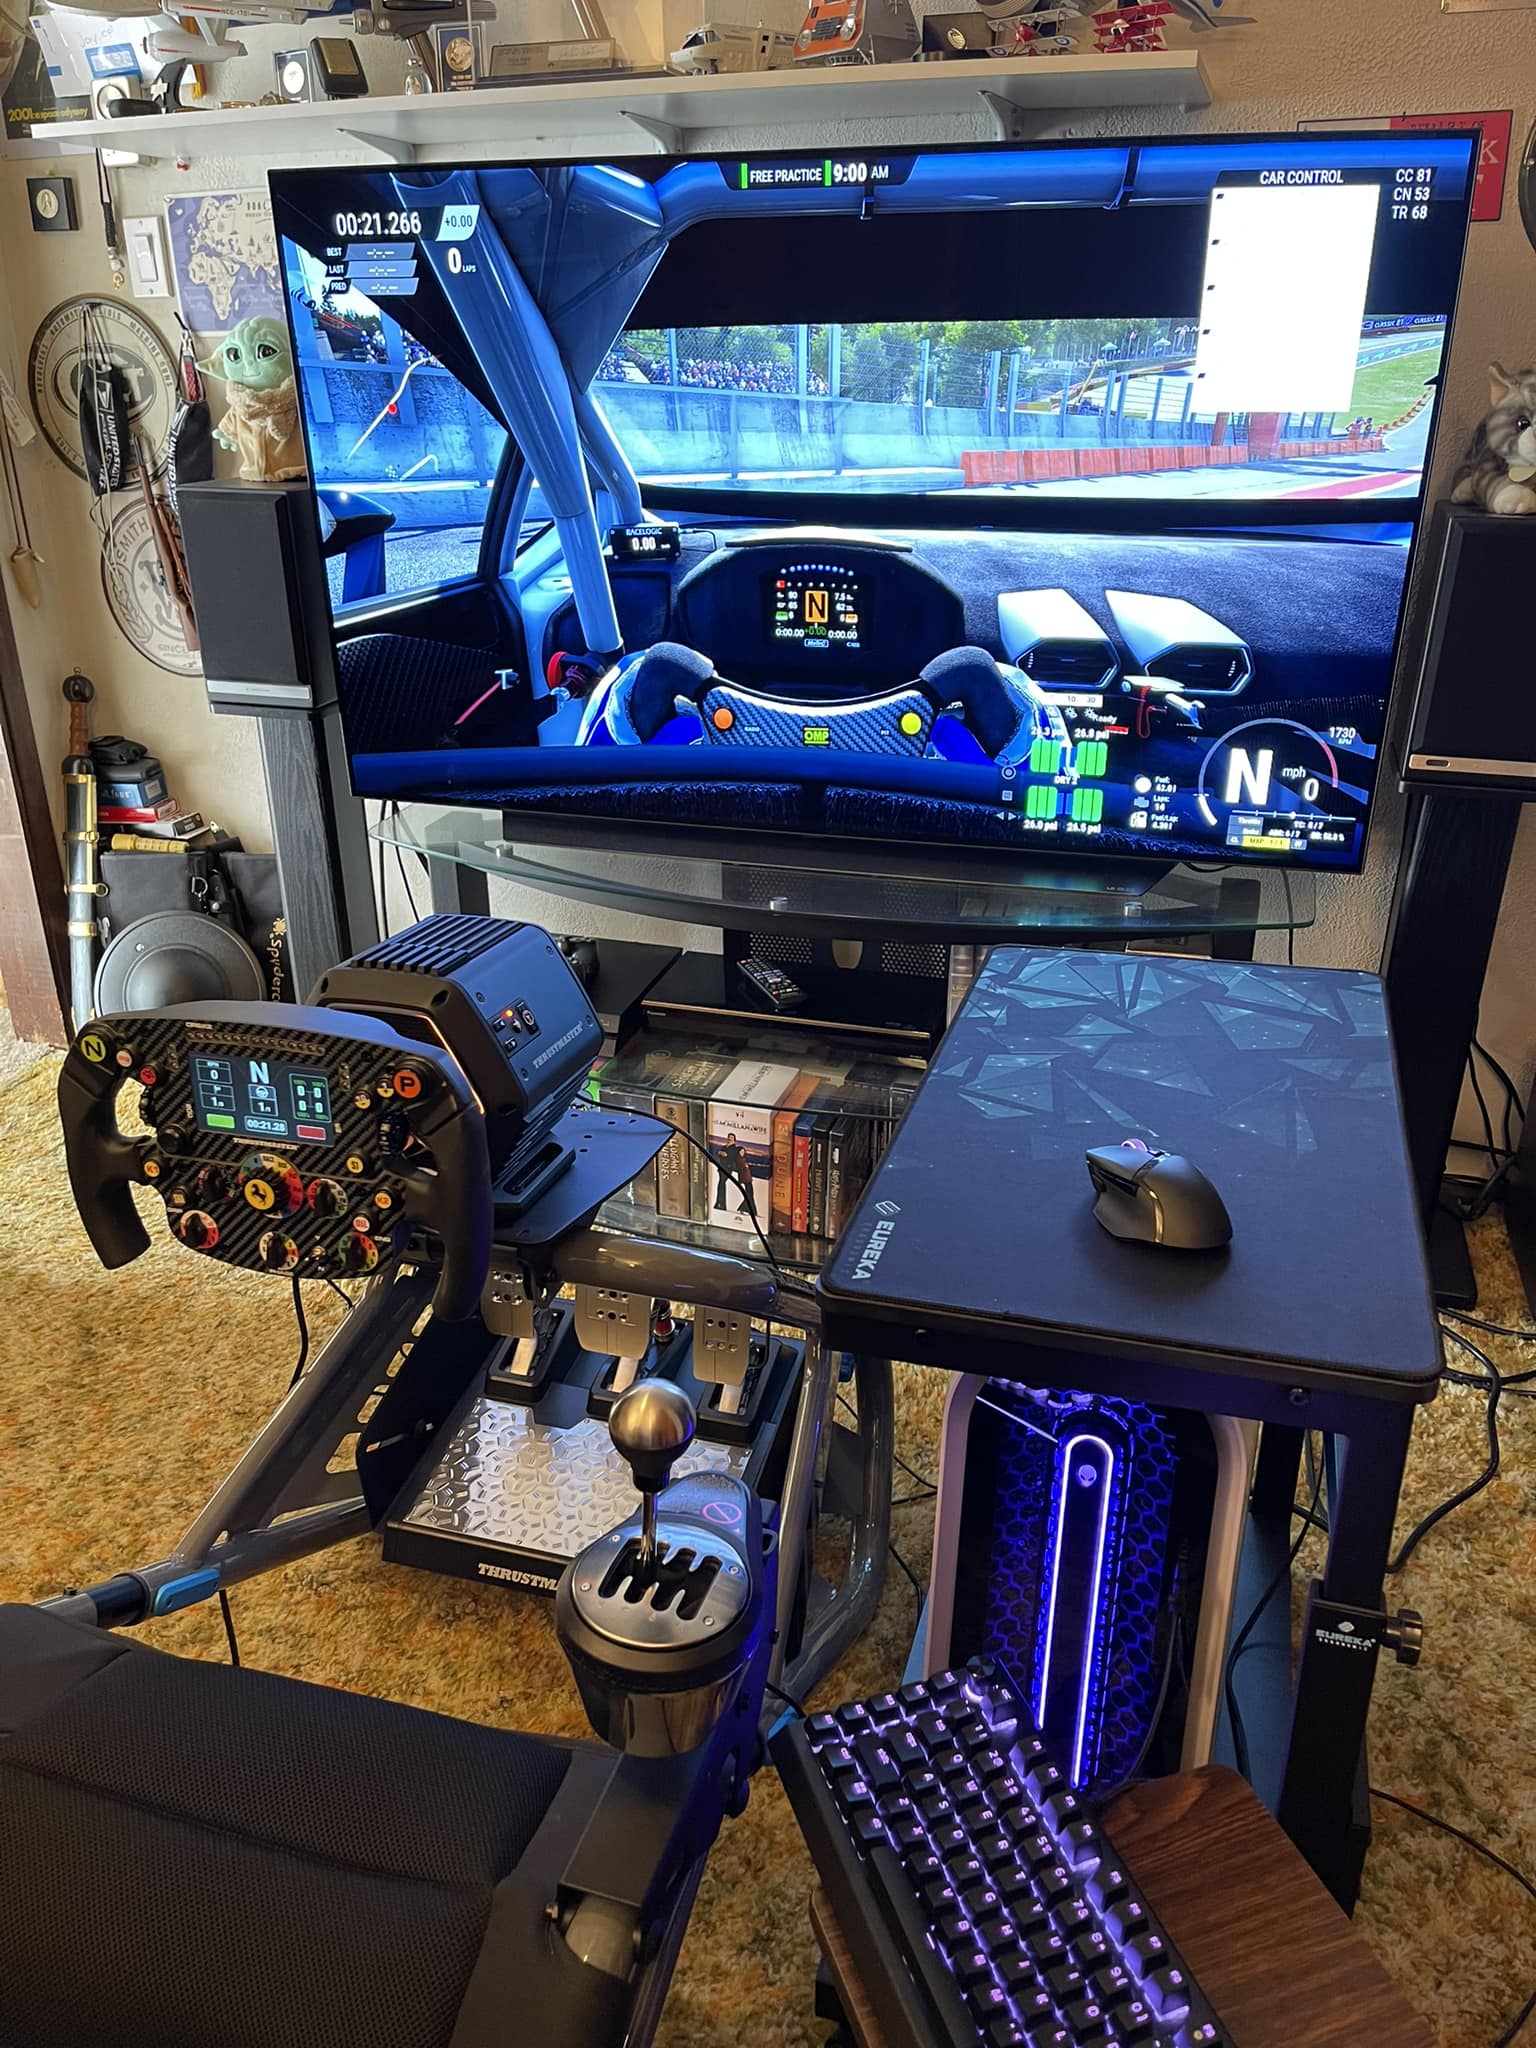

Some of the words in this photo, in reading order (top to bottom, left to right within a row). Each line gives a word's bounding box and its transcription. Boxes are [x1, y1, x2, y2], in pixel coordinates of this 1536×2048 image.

[750, 169, 774, 183] FREE
[774, 167, 822, 183] PRACTICE
[833, 162, 867, 183] 9:00
[870, 165, 889, 179] AM
[1259, 170, 1285, 185] CAR
[1286, 169, 1344, 184] CONTROL
[1395, 168, 1414, 183] CC
[1416, 168, 1432, 183] 81
[1393, 187, 1412, 201] CN
[1414, 186, 1430, 201] 53
[445, 214, 473, 228] +0.00
[1391, 205, 1408, 220] TR
[1411, 205, 1428, 220] 68
[336, 211, 422, 236] 00:21.266
[326, 247, 342, 257] BEST
[447, 247, 462, 274] 0
[462, 264, 476, 273] LAPS
[328, 265, 345, 274] LAST
[330, 281, 347, 291] PRED
[106, 414, 121, 456] UNITED
[168, 435, 178, 481] UNITED
[116, 517, 149, 563] SMITH
[625, 527, 662, 536] RACELOGIC
[631, 536, 656, 551] 0.00
[807, 592, 826, 618] N
[803, 729, 830, 743] OMP
[1329, 726, 1357, 739] 1730
[1054, 775, 1070, 785] DRY
[1225, 747, 1274, 806] N
[1282, 765, 1306, 780] mph
[1304, 777, 1320, 801] 0
[266, 939, 285, 1001] Spyderc
[532, 1022, 584, 1069] THRUSTMASTER
[249, 1060, 270, 1084] N
[775, 1153, 788, 1199] DUNE
[851, 1220, 896, 1280] EUREKA
[477, 1562, 560, 1591] THRUSTM
[1315, 1628, 1373, 1648] EUREKA
